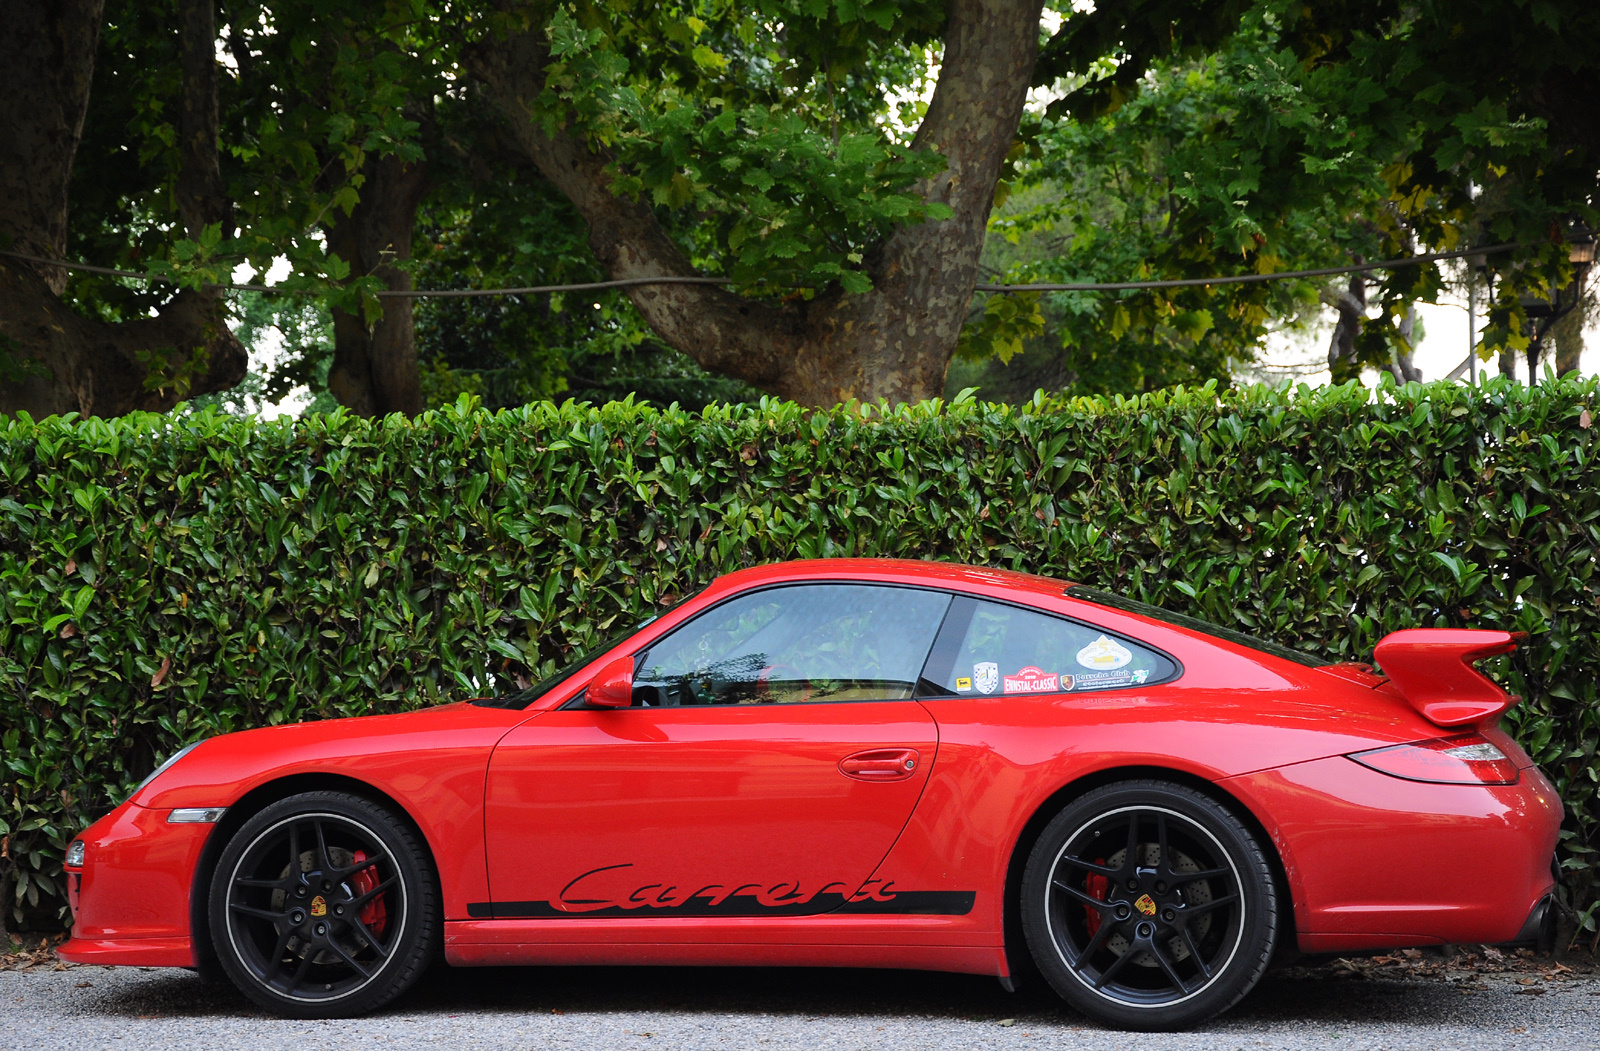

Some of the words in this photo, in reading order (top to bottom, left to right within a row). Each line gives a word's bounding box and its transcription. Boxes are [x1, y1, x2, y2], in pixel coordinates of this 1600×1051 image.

[1005, 676, 1057, 692] ENNSTAL-CLASSIC
[1075, 672, 1109, 681] Porsche
[548, 863, 897, 913] Carrera
